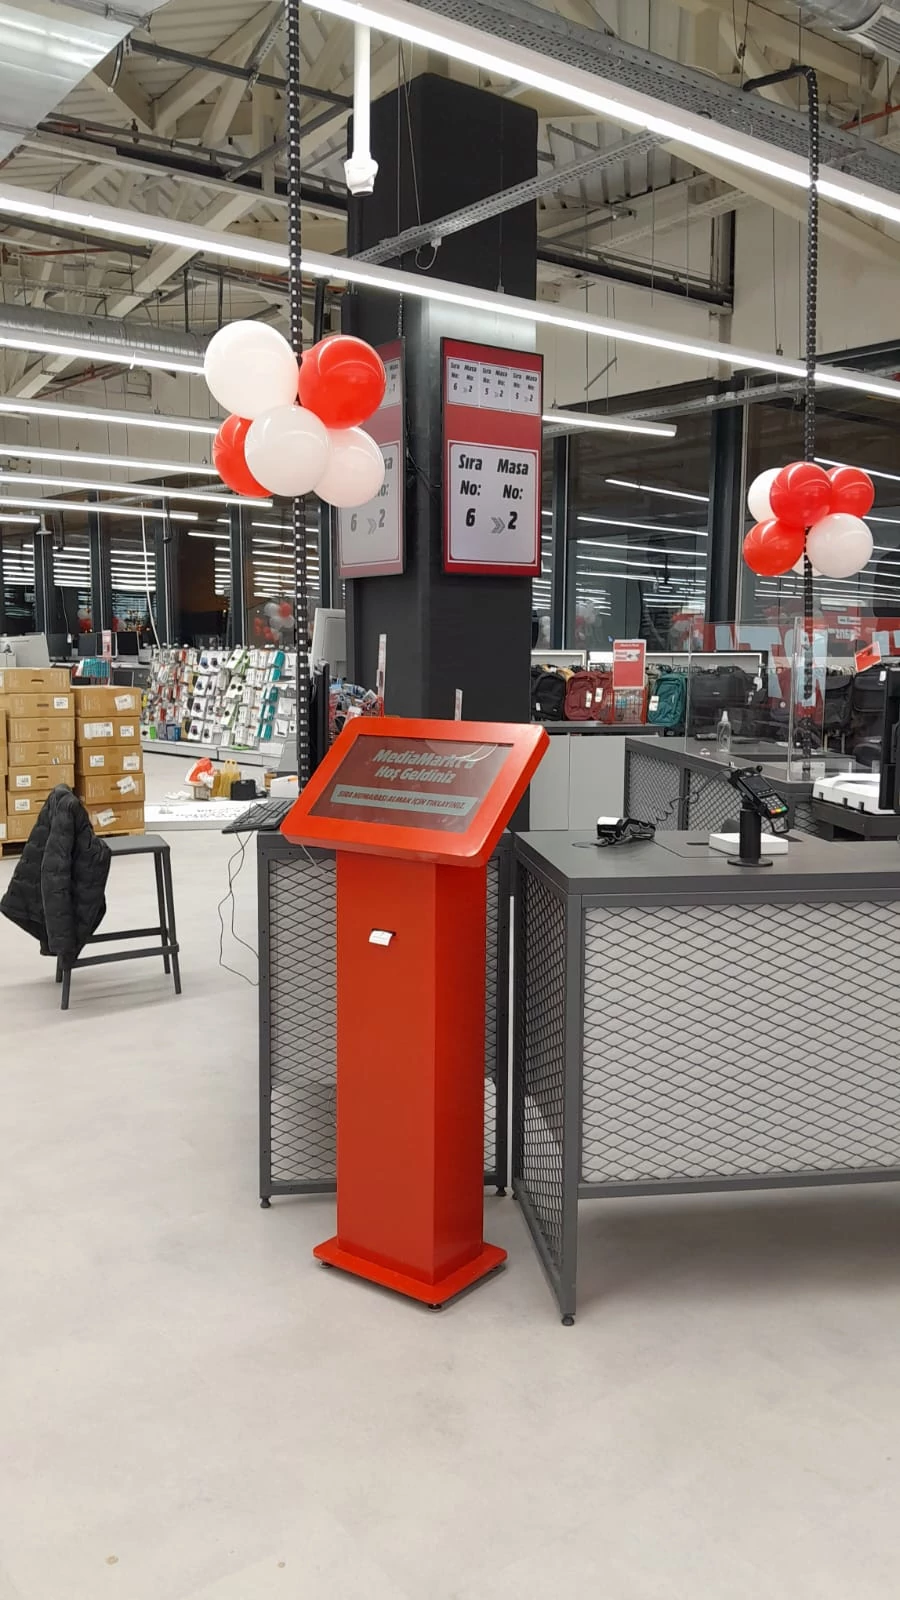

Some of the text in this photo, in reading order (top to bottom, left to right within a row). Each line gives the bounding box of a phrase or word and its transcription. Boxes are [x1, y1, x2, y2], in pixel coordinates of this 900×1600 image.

[458, 454, 529, 475] Sıra Masa
[460, 480, 524, 500] No: No:
[350, 509, 386, 532] 6 2
[465, 508, 518, 529] 6 2
[375, 766, 456, 783] Hoş Geldiniz
